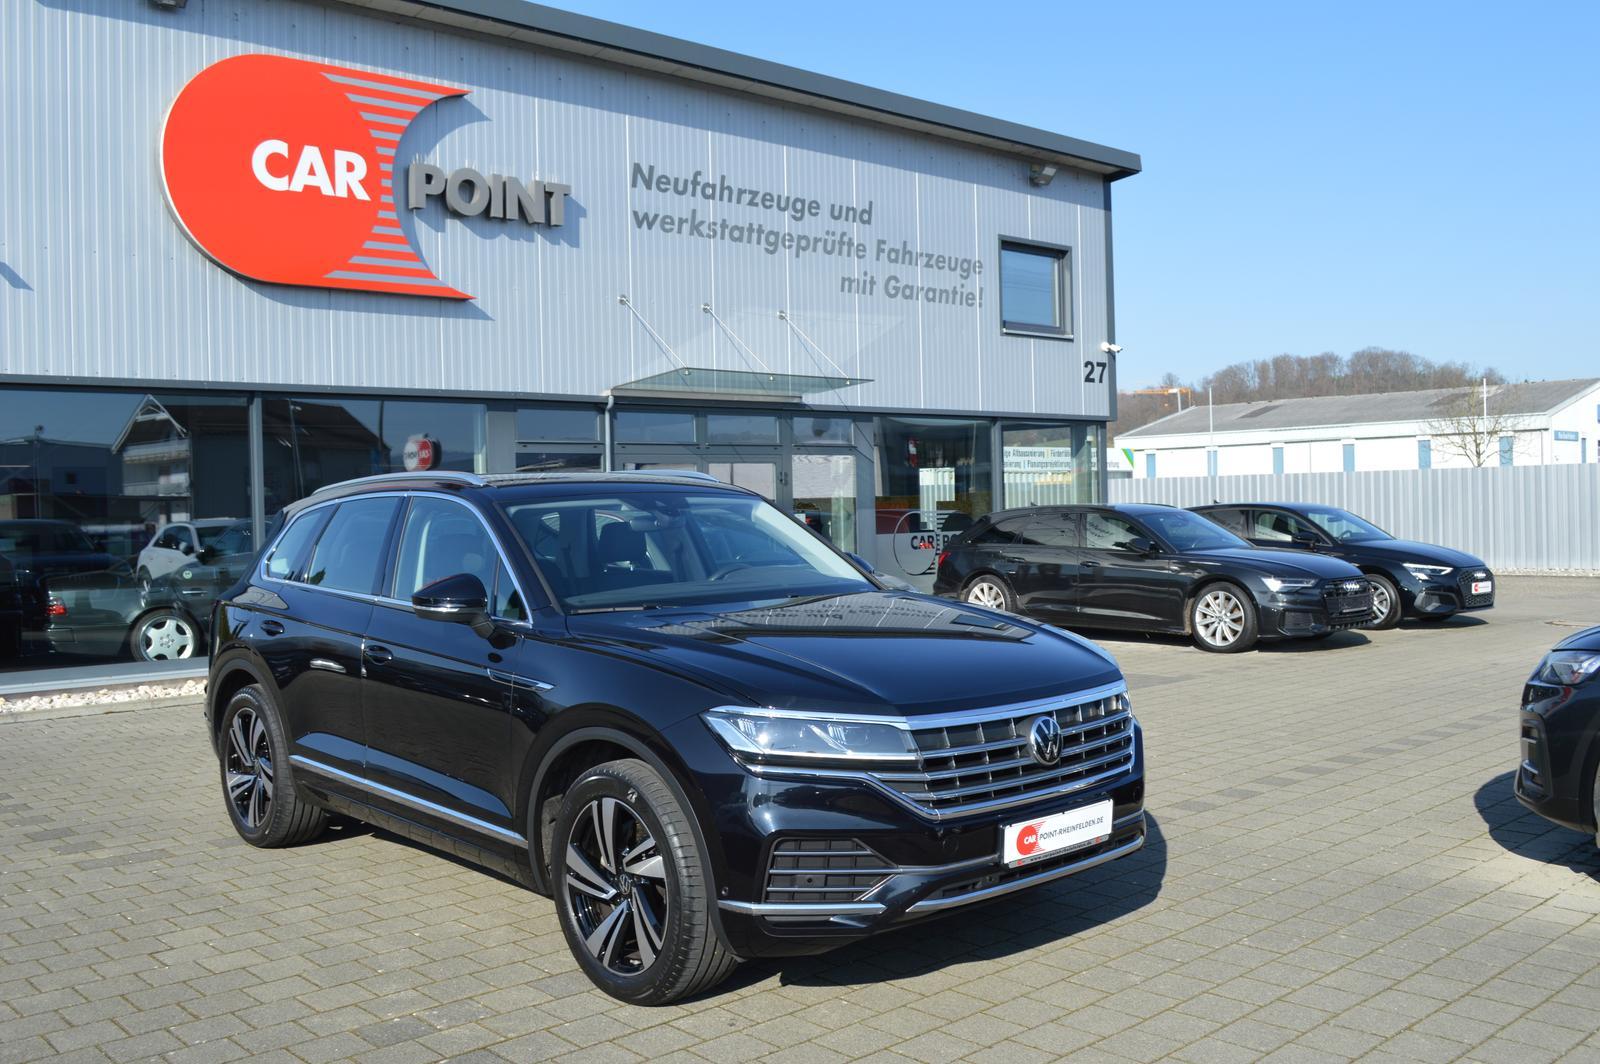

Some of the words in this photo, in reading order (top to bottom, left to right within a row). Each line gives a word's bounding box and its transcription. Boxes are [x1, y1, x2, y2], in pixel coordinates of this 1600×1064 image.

[251, 139, 371, 201] CAR
[408, 161, 571, 227] POINT
[631, 162, 821, 221] Neufahrzeuge
[830, 201, 873, 225] und
[632, 208, 867, 259] werkstattgeprüfte
[876, 239, 983, 280] Fahrzeuge
[840, 271, 876, 296] mit
[884, 275, 984, 308] Garantie!
[1084, 360, 1107, 384] 27
[910, 535, 935, 551] CAR
[1023, 834, 1037, 845] CAR
[1039, 816, 1105, 841] POINT-RHEINFELDEN.DE
